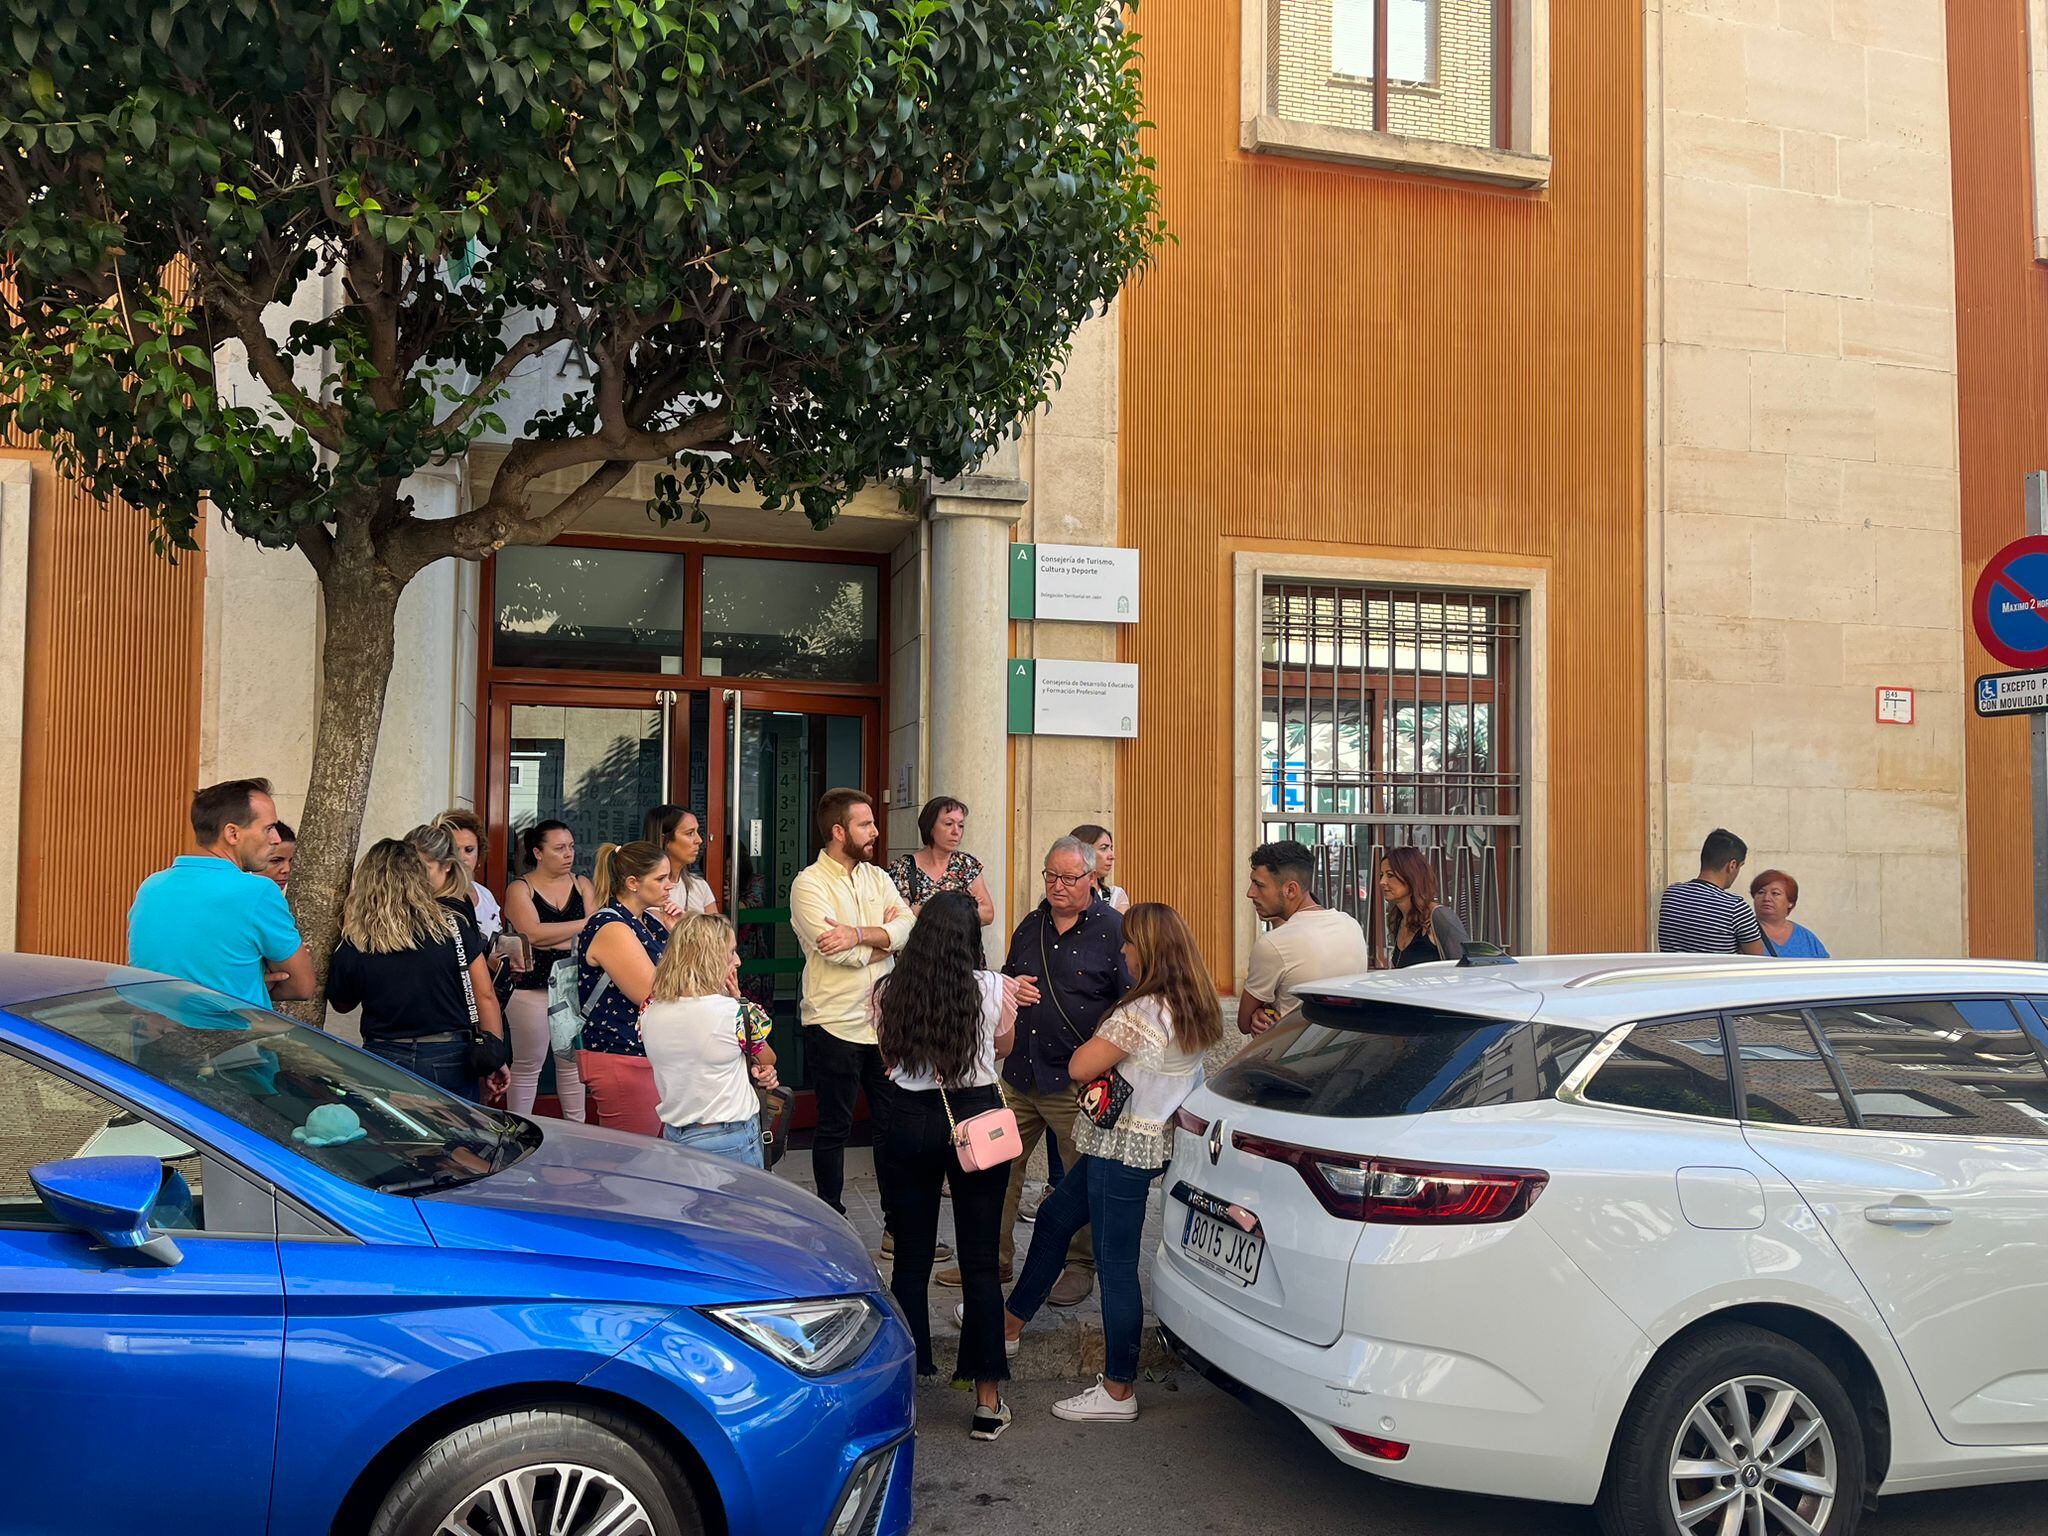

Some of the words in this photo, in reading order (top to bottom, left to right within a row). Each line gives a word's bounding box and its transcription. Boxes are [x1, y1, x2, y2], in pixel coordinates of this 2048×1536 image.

[1040, 555, 1076, 564] Consejería
[1086, 557, 1115, 567] Turismo,
[1040, 565, 1065, 573] Cultura
[1071, 567, 1098, 575] Deporte
[2029, 598, 2036, 610] 2
[1042, 679, 1071, 687] Consejería
[1107, 681, 1134, 689] Educativo
[2001, 679, 2036, 693] EXCEPTO
[2042, 678, 2048, 689] P
[1981, 700, 1997, 711] CON
[1999, 694, 2044, 709] MOVILIDAD
[782, 862, 792, 877] B
[468, 1005, 479, 1024] 1980
[1191, 1216, 1224, 1257] 8015
[1225, 1234, 1256, 1273] JXC
